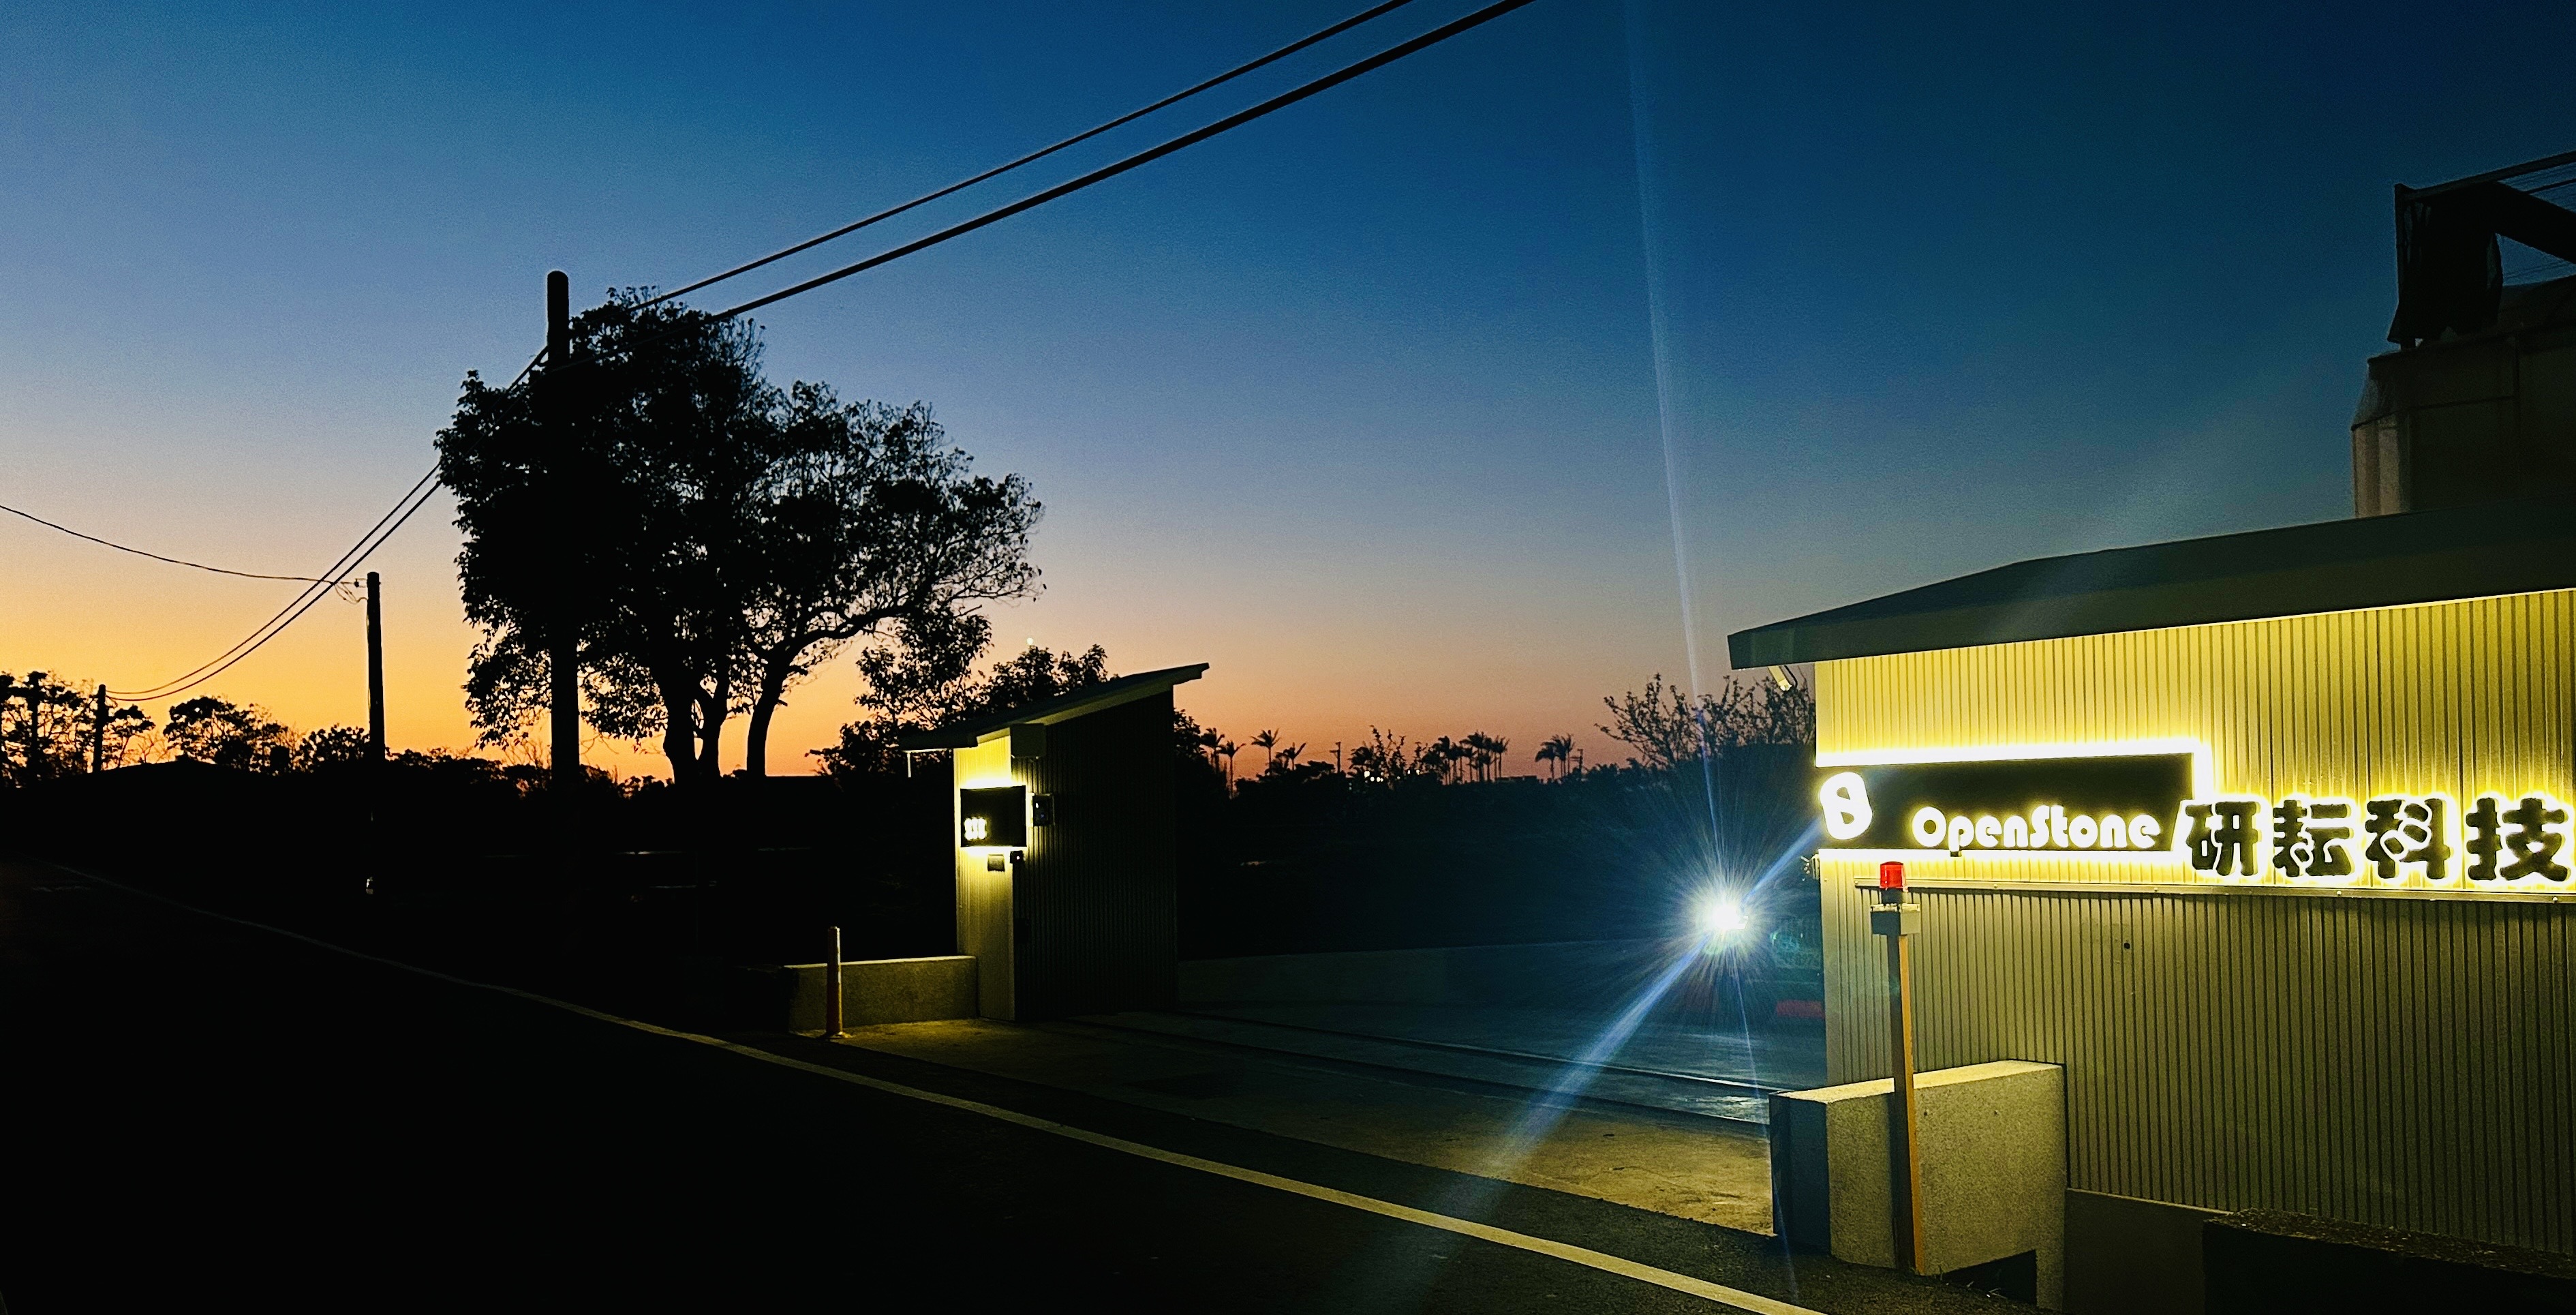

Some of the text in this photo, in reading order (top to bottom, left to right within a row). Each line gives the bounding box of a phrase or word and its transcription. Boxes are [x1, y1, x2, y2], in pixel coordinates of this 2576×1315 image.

[1912, 804, 2160, 852] OpenStone
[2185, 798, 2571, 881] 研耘科技
